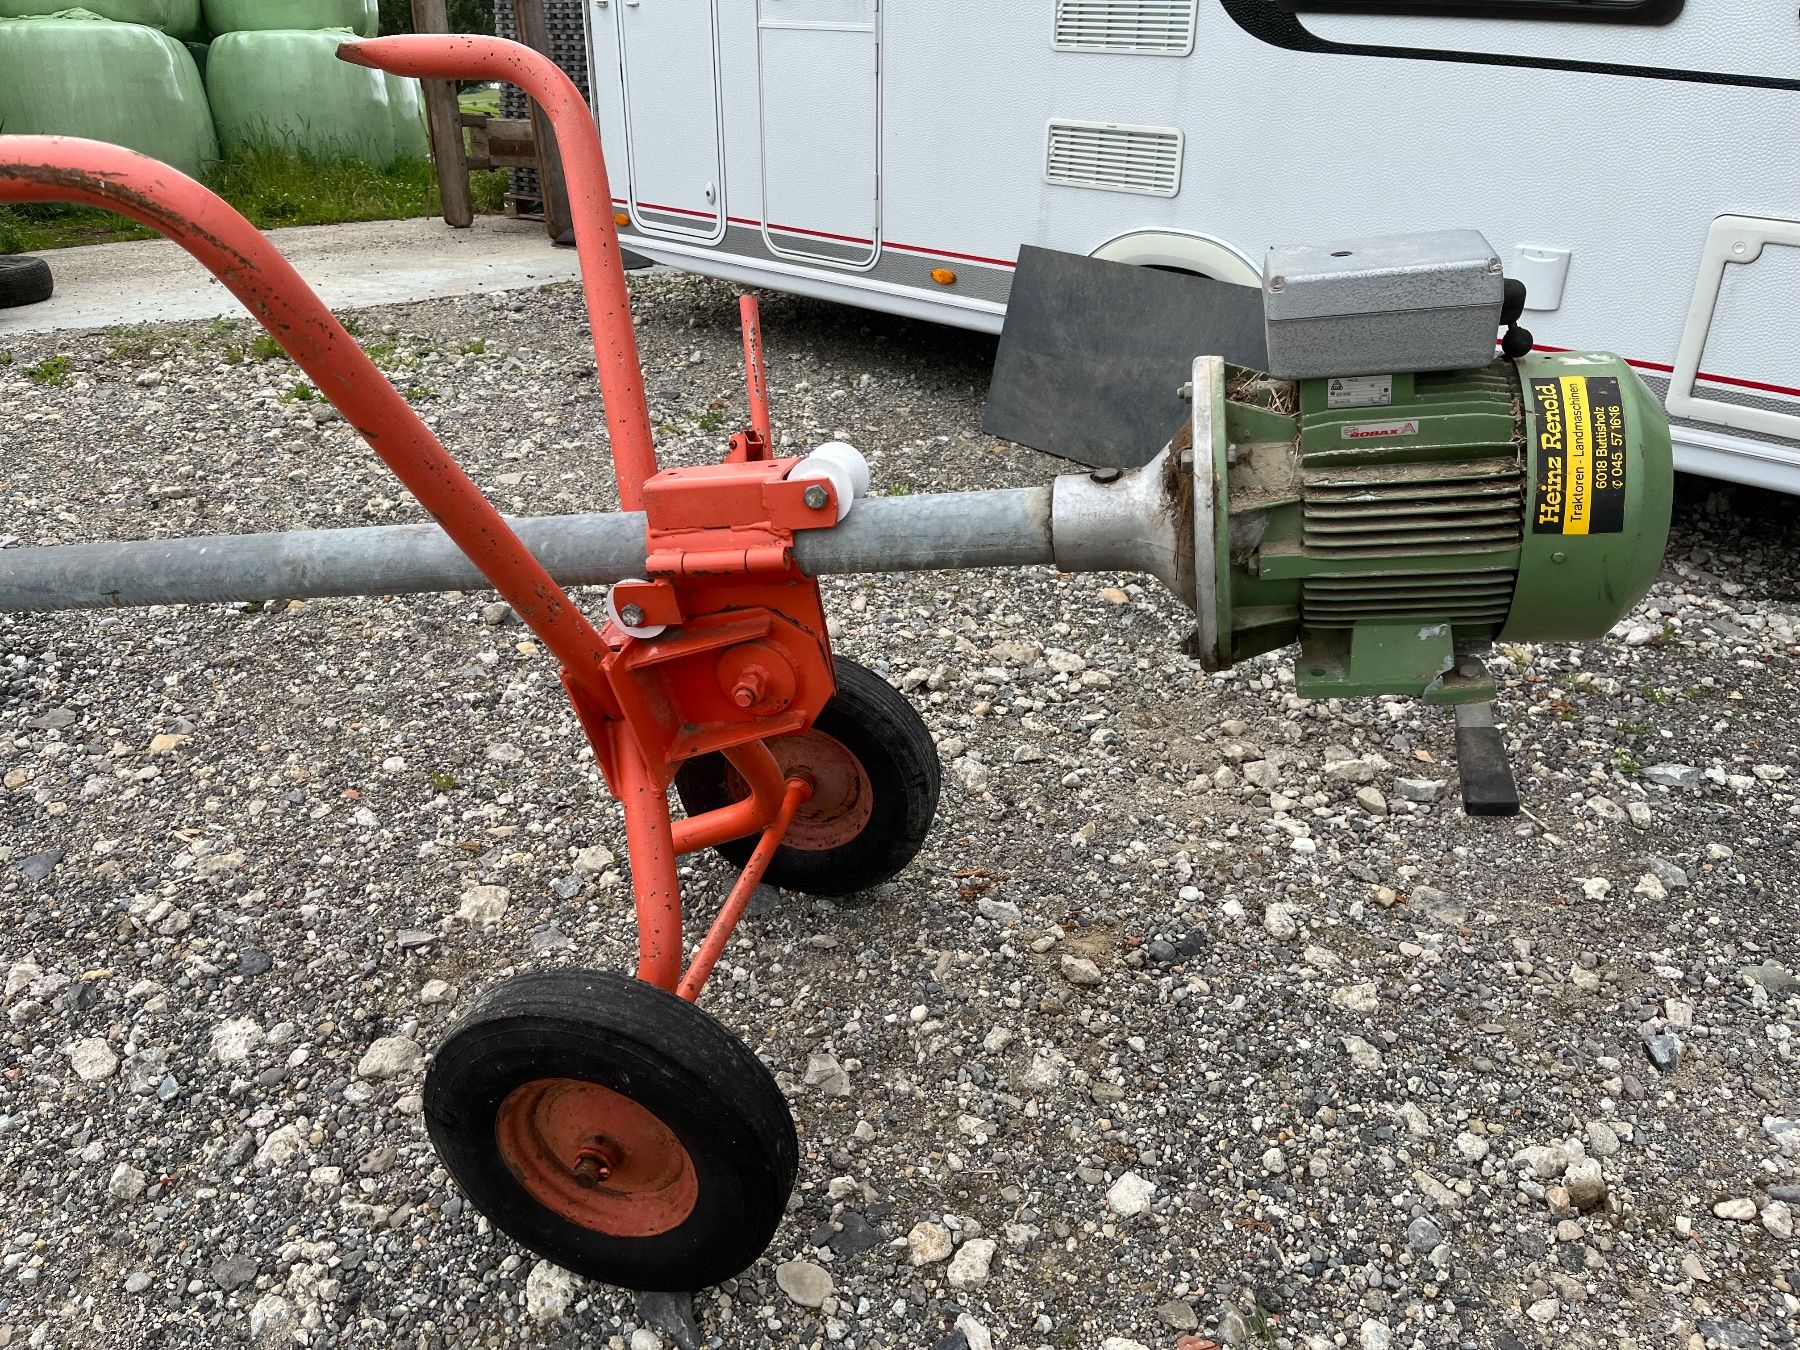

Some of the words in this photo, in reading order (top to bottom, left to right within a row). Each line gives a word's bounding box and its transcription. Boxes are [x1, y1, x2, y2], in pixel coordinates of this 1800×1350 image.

[1535, 383, 1562, 450] Renold
[1570, 383, 1585, 457] Landmaschinen
[1594, 406, 1608, 457] Buttisholz
[1611, 432, 1623, 446] 57
[1539, 457, 1562, 525] Heinz
[1595, 461, 1608, 489] 6018
[1611, 452, 1623, 477] 045
[1570, 466, 1585, 522] Traktoren
